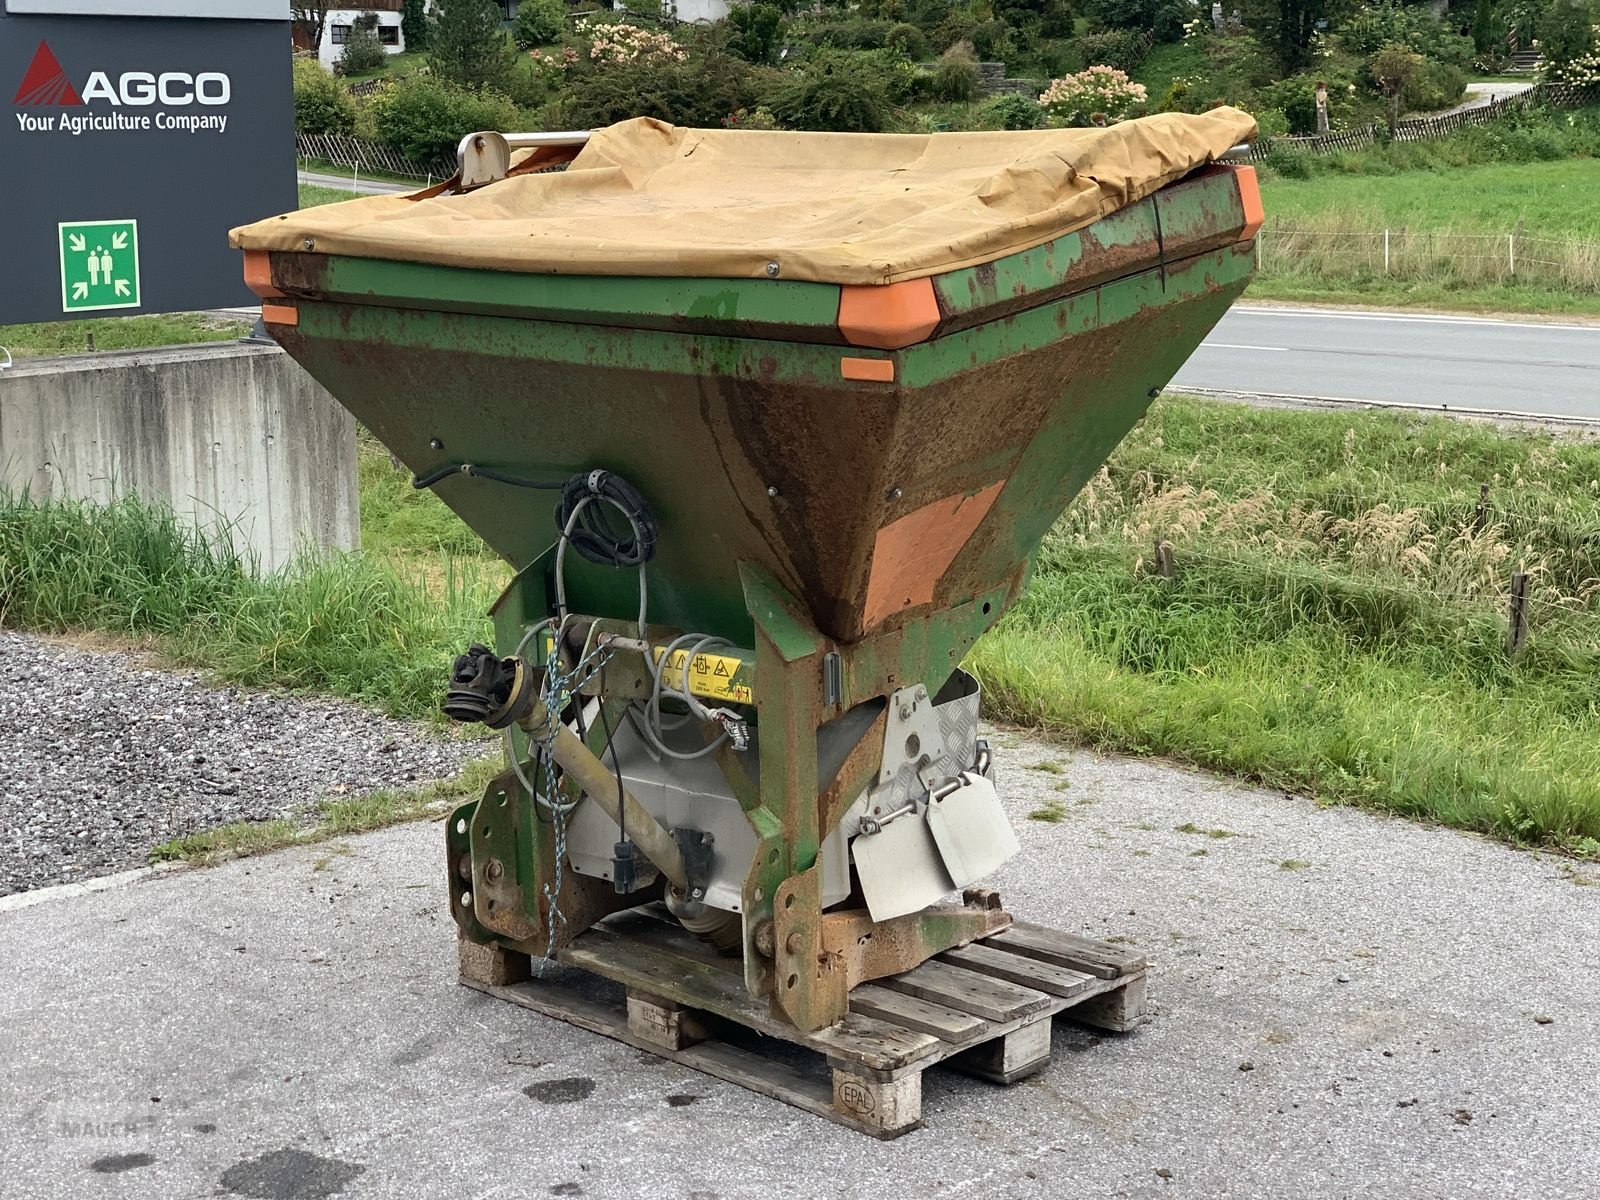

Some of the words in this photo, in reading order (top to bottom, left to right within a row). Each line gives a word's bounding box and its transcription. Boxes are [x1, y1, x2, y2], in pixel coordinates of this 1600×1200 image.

[81, 71, 231, 106] AGCO
[16, 113, 55, 131] Your
[59, 111, 150, 135] Agriculture
[155, 112, 227, 133] Company
[844, 1086, 871, 1110] EPAL
